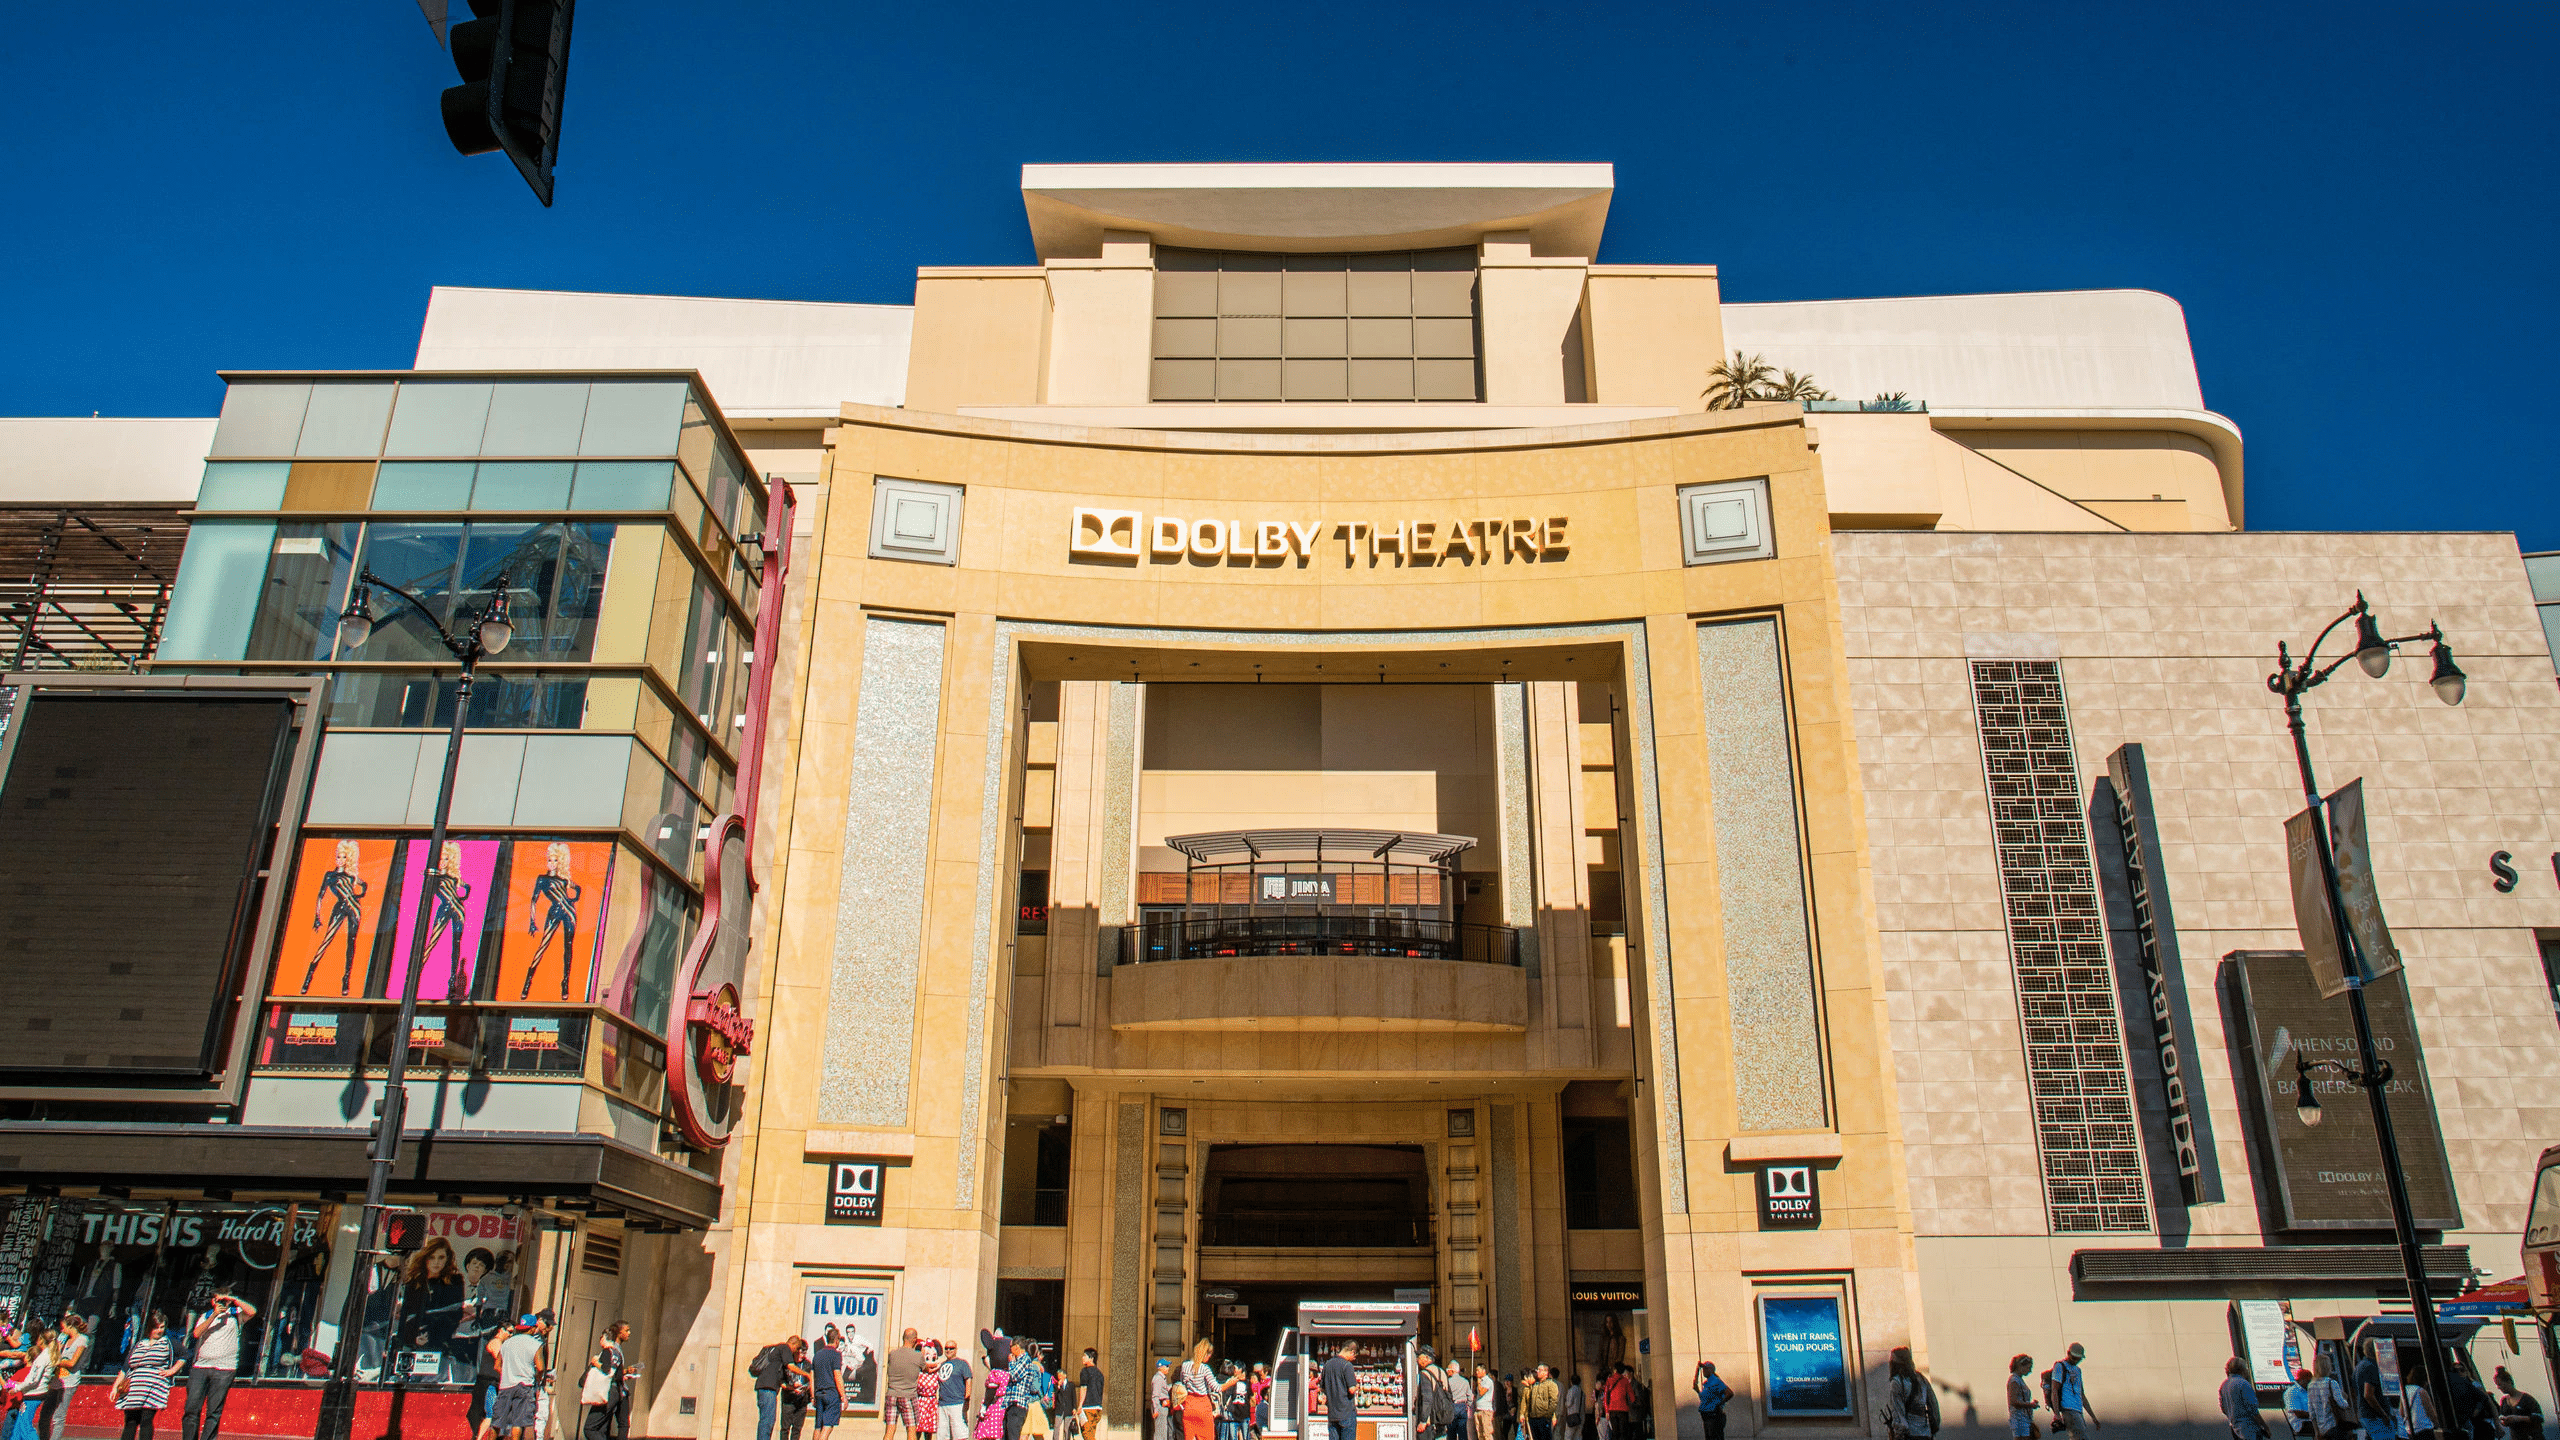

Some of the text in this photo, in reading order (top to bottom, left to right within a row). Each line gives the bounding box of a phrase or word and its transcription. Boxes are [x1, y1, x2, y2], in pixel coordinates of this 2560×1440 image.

[1150, 516, 1571, 563] DOLBY THEATRE
[2115, 773, 2157, 958] THEATRE
[1290, 880, 1331, 897] JINYA
[2357, 916, 2379, 937] NOV
[2147, 969, 2185, 1108] DOLBY
[2335, 1037, 2395, 1051] SOND
[2277, 1080, 2357, 1094] BARIERS
[2336, 1172, 2372, 1182] DOLBY
[834, 1196, 876, 1208] DOLBY
[1769, 1199, 1812, 1212] DOLBY
[833, 1209, 876, 1217] THEATRE
[1770, 1212, 1814, 1220] THEATRE
[83, 1213, 163, 1246] THIS
[217, 1218, 317, 1247] Hard Rck
[1572, 1291, 1640, 1301] LOUIS VUITTON
[814, 1295, 878, 1316] IL VOLO
[1772, 1332, 1799, 1341] WHEN
[1800, 1332, 1807, 1341] IT
[1774, 1343, 1837, 1352] SOUND POURS.
